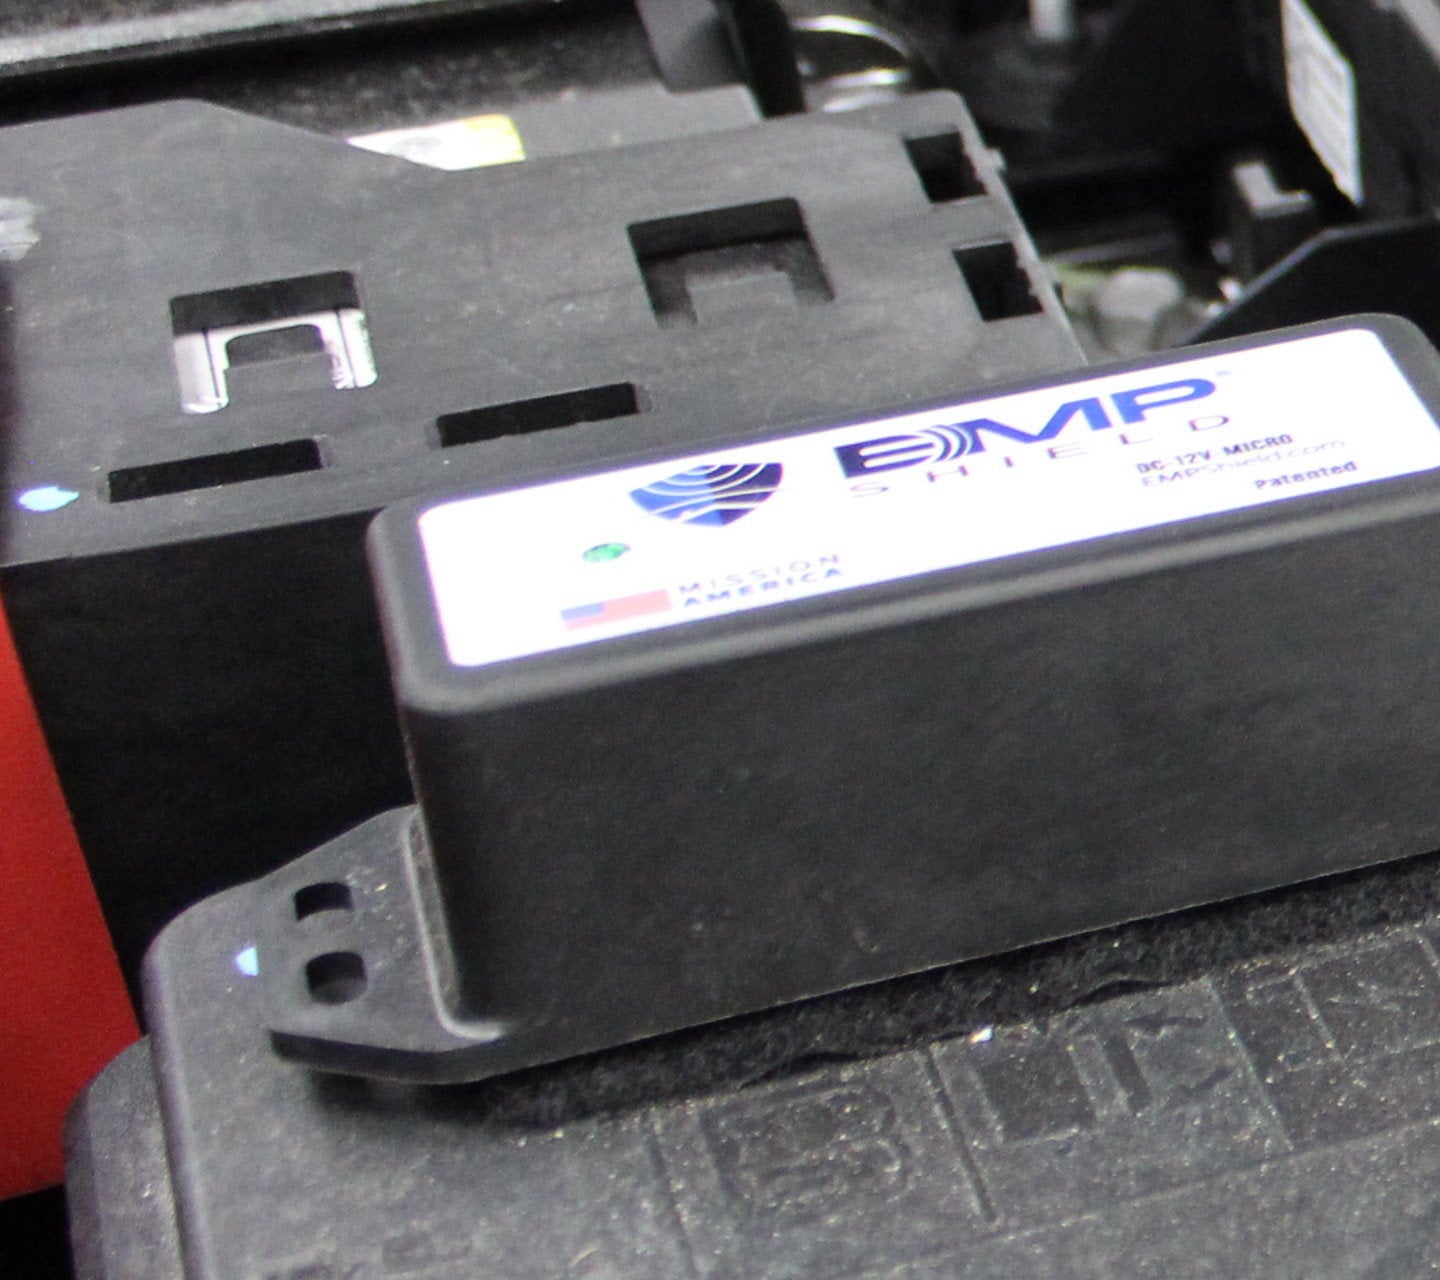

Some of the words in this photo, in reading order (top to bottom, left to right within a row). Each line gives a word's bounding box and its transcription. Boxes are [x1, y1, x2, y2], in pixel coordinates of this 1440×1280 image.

[833, 378, 1216, 478] EMP
[850, 415, 1231, 497] SHIELD
[1254, 461, 1357, 490] Patented
[679, 554, 838, 594] MISSION
[684, 568, 842, 607] AMERICA
